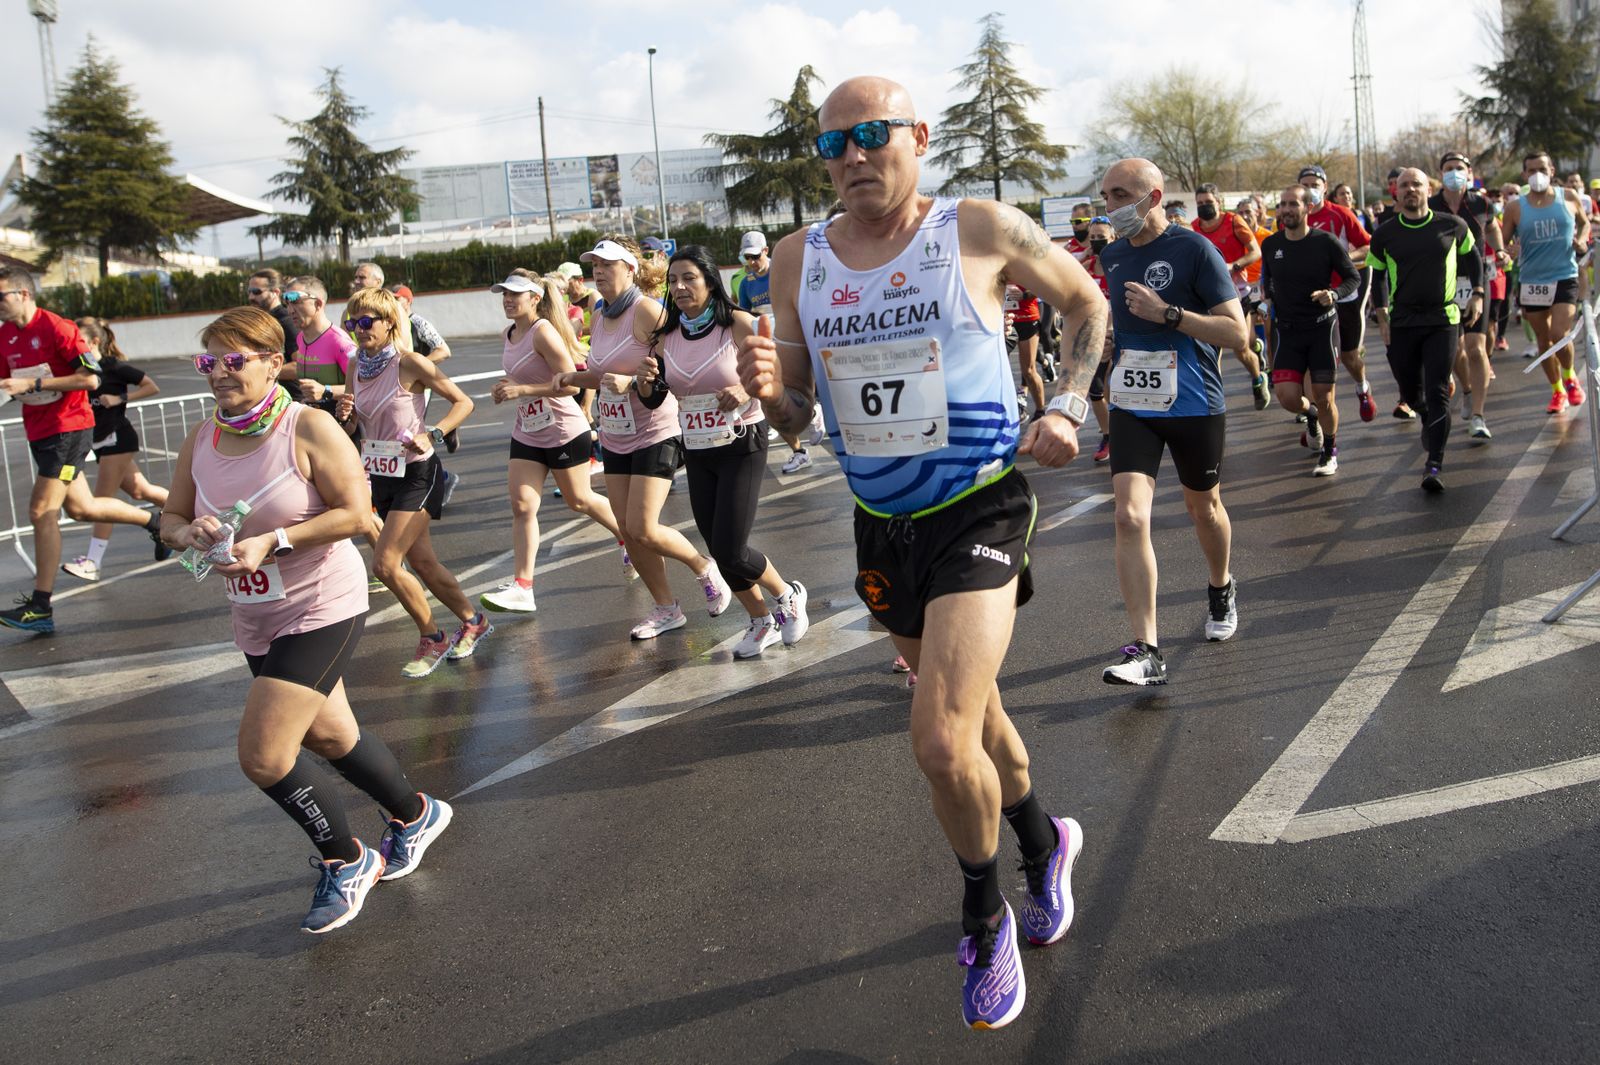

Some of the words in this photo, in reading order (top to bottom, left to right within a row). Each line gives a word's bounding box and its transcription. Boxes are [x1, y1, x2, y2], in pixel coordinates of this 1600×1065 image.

[1533, 218, 1559, 239] ENA
[884, 284, 920, 301] mayfo
[1527, 285, 1549, 296] 358
[813, 300, 941, 338] MARACENA
[827, 339, 851, 348] CLUB
[854, 336, 867, 345] DE
[871, 327, 926, 343] ATLETISMO
[1123, 369, 1162, 389] 535
[860, 379, 905, 417] 67
[685, 410, 727, 430] 2152
[364, 456, 398, 474] 2150
[1049, 854, 1063, 891] balance
